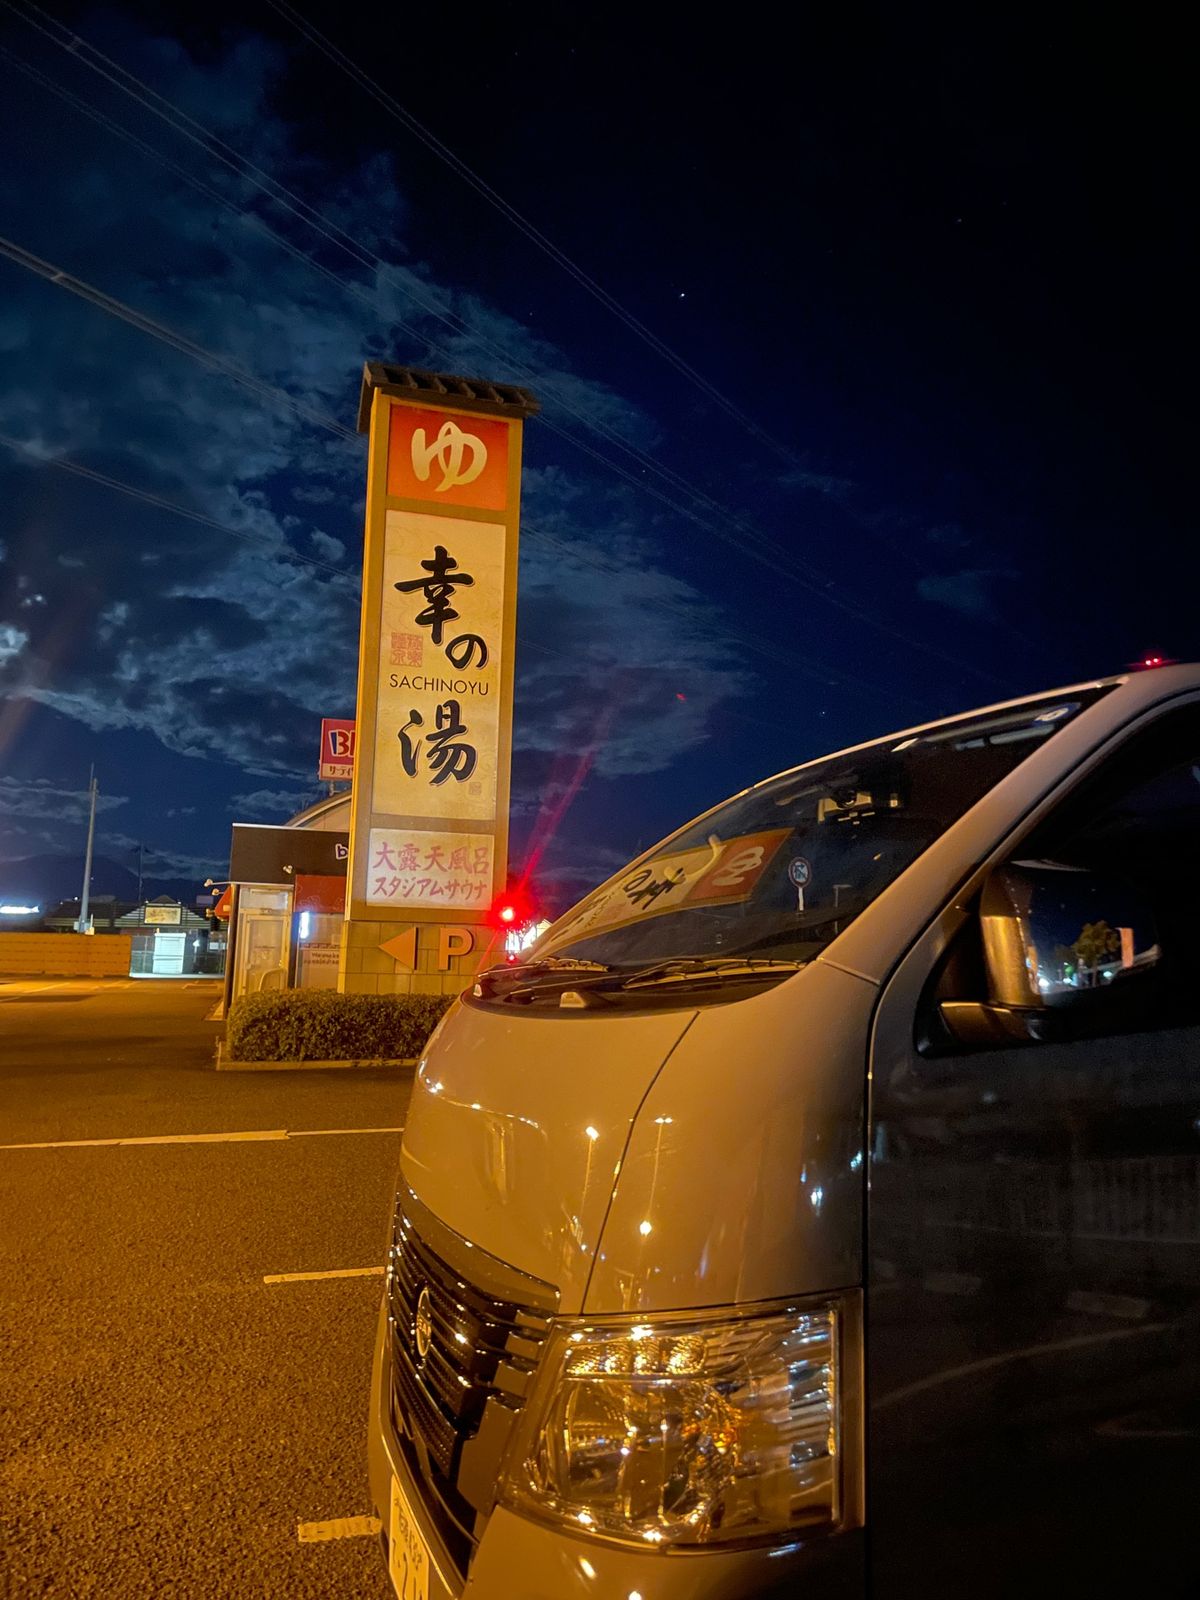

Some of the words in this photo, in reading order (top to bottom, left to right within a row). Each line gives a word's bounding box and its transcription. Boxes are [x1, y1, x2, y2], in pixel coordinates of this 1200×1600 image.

[410, 420, 488, 492] ゆ
[389, 673, 489, 696] SACHINOYU
[329, 765, 354, 776] サーティ
[372, 841, 490, 875] 大露天風呂
[372, 876, 488, 901] スタジアムサウナ
[438, 927, 475, 971] P
